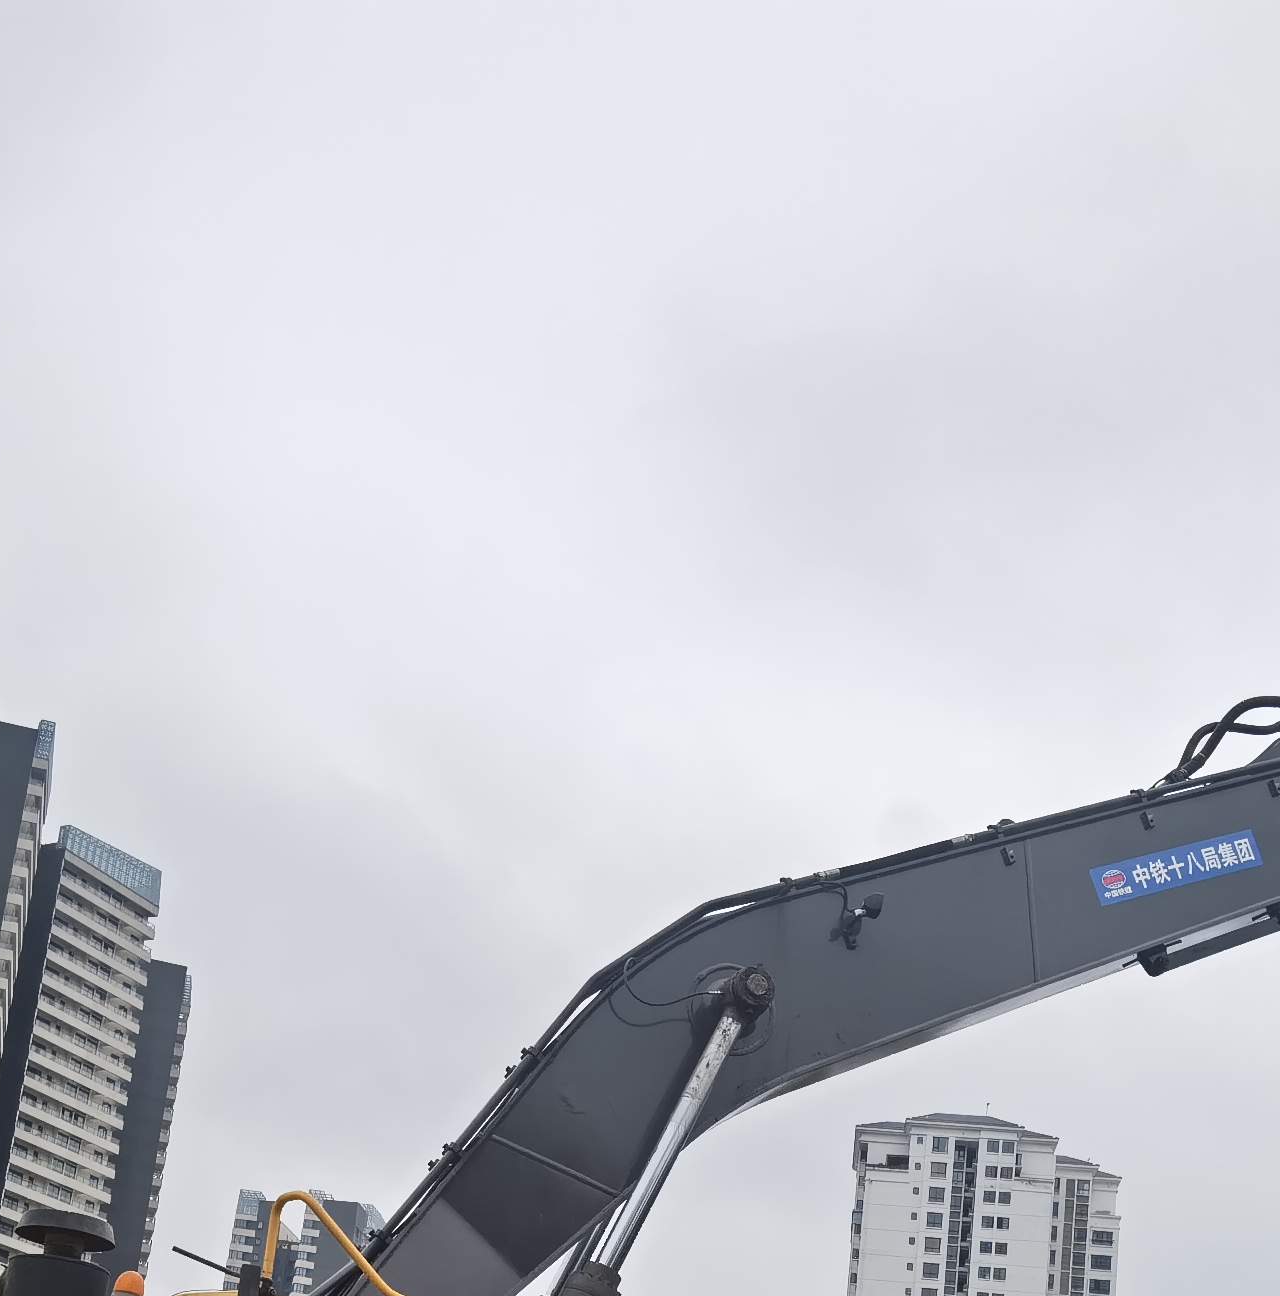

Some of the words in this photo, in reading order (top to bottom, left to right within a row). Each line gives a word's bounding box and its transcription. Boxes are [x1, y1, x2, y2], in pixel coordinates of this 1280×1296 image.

[1132, 838, 1256, 889] 中铁十八局集团
